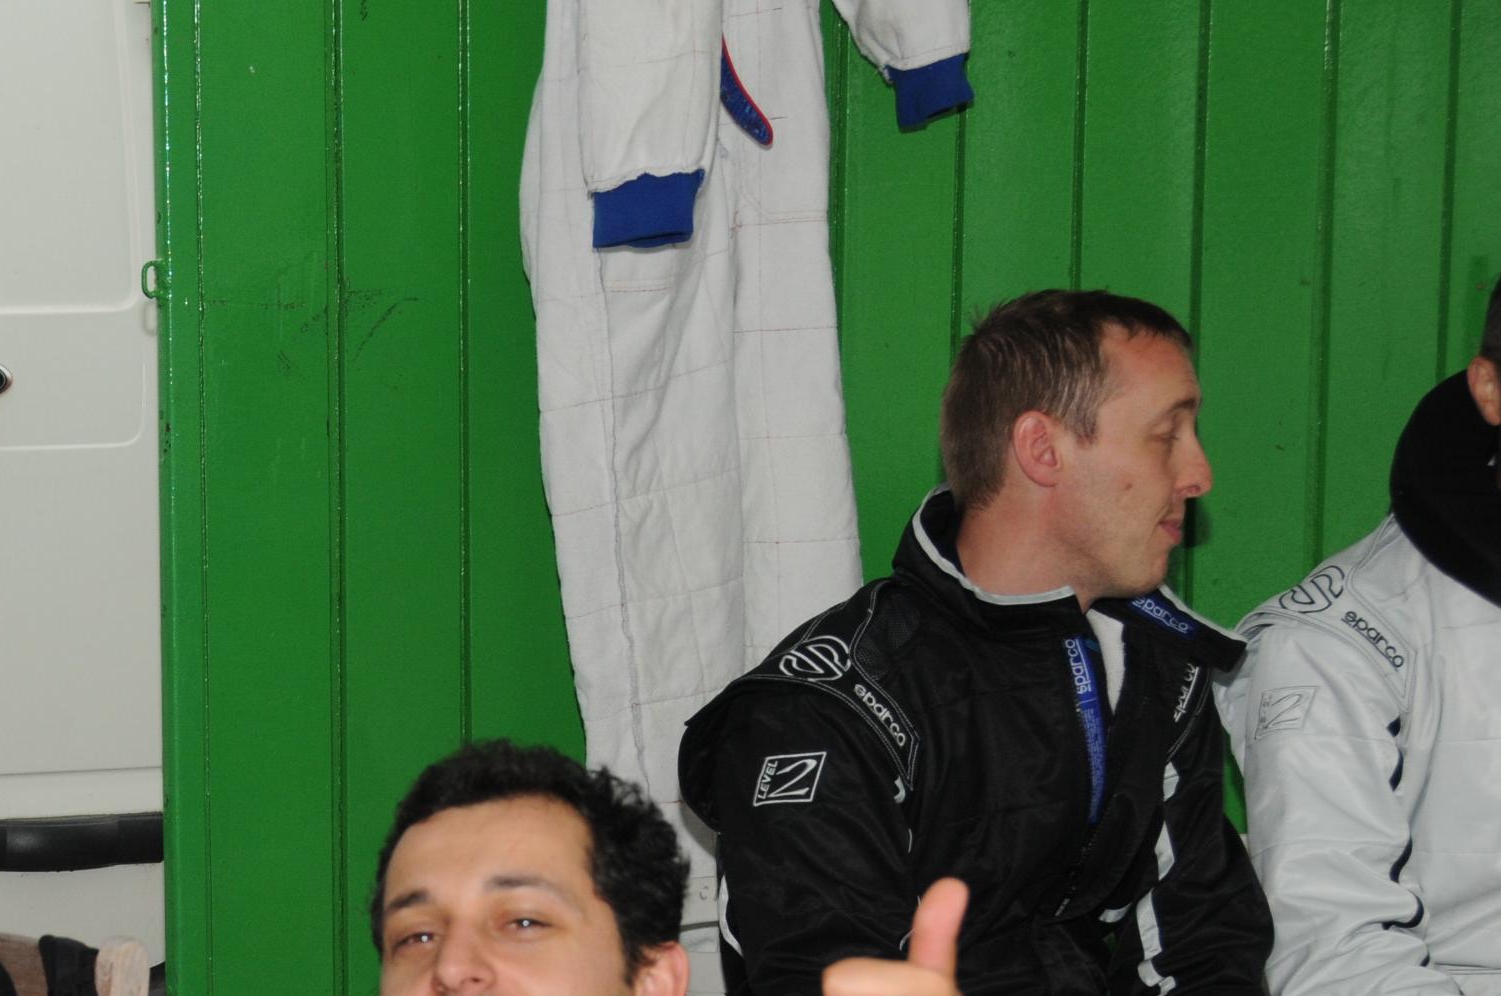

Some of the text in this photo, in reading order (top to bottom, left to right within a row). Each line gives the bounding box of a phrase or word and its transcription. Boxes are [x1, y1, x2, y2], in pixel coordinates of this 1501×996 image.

[1132, 597, 1190, 634] sparco
[1344, 611, 1405, 669] sparco
[1065, 638, 1092, 694] sparco
[854, 683, 906, 746] sparco
[756, 760, 779, 800] LEVEL
[767, 758, 818, 798] 2
